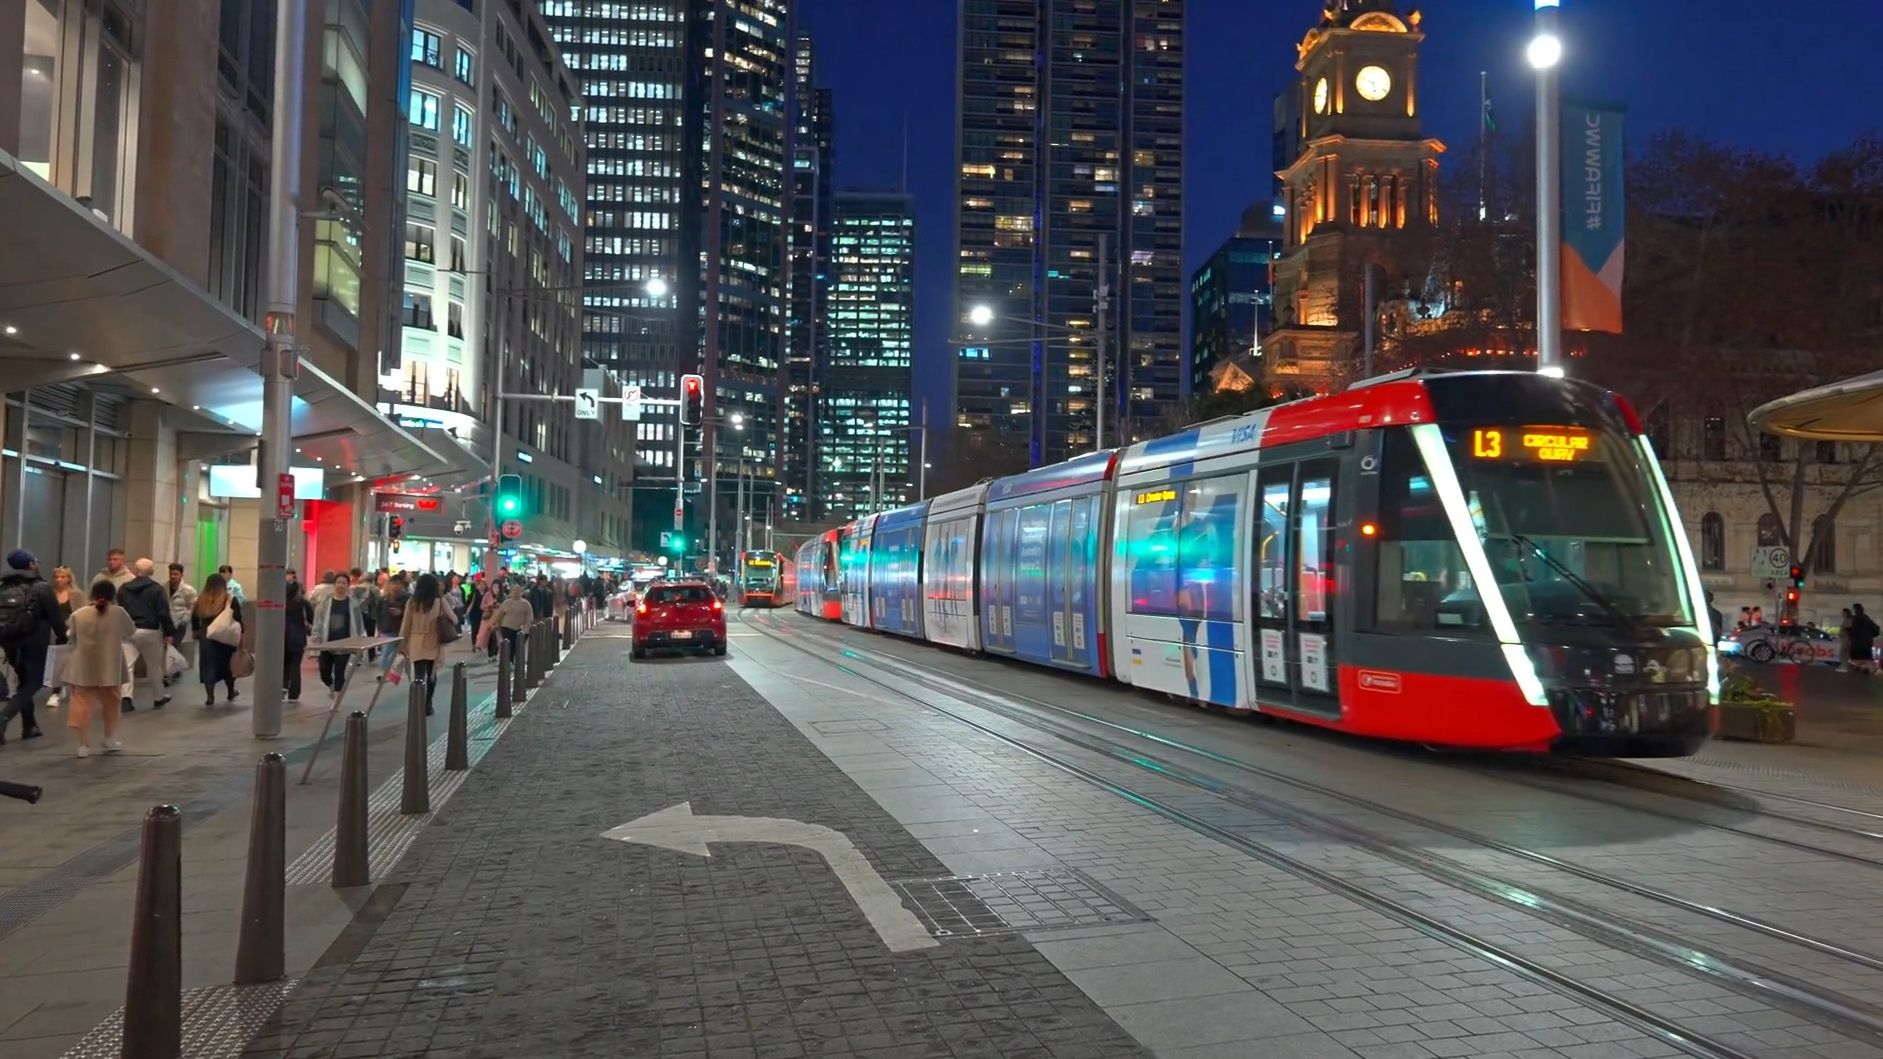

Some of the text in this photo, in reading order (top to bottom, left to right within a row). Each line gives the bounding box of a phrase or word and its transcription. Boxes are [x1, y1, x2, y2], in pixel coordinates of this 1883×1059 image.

[1231, 423, 1257, 443] VISA
[1523, 434, 1588, 449] CIRCULAR
[1474, 430, 1501, 457] L3
[1773, 553, 1786, 563] 40
